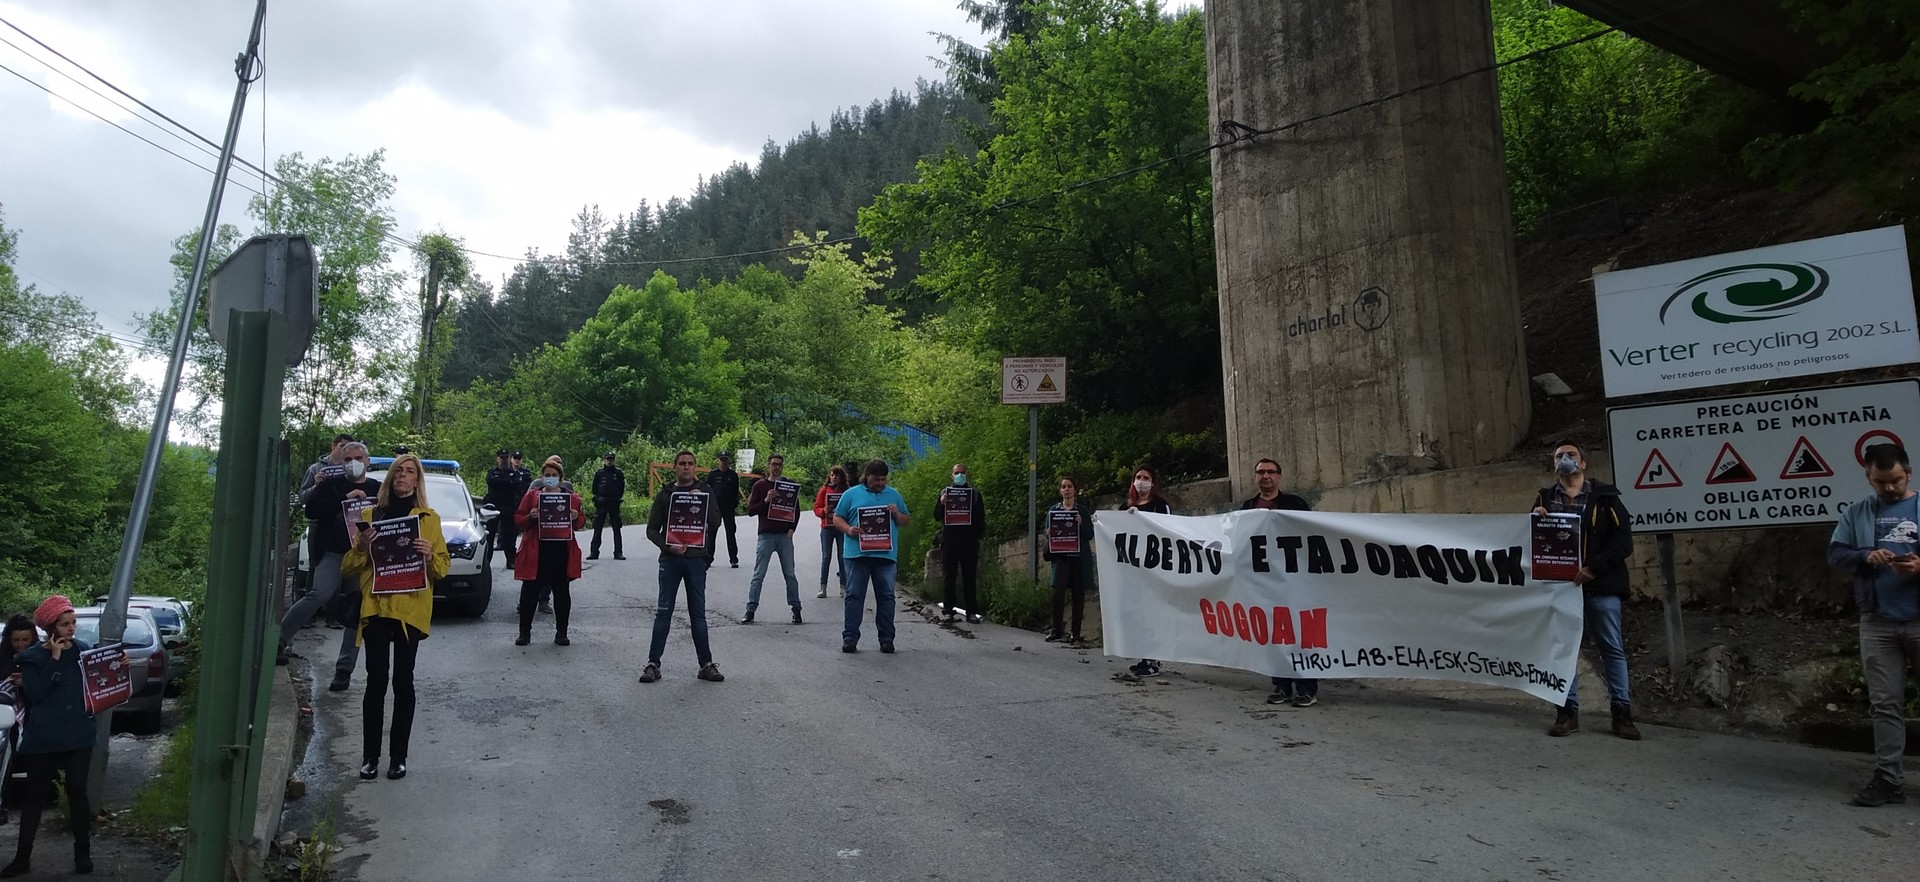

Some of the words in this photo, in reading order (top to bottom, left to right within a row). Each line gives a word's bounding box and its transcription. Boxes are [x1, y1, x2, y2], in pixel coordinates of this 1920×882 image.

[1608, 342, 1700, 367] Verter
[1713, 330, 1819, 357] recycling
[1826, 323, 1875, 342] 2002
[1879, 320, 1911, 335] S.L.
[1660, 370, 1711, 380] Vertedero
[1730, 361, 1774, 373] residuos
[1777, 359, 1790, 367] no
[1794, 352, 1850, 366] peligrosos
[1696, 393, 1819, 419] PRECAUCIÓN
[1636, 421, 1744, 441] CARRETERA
[1757, 417, 1782, 431] DE
[1791, 405, 1892, 428] MONTAÑA
[1719, 459, 1736, 472] 15%
[1703, 485, 1832, 505] OBLIGATORIO
[1694, 508, 1731, 522] CON
[1738, 507, 1760, 520] LA
[1766, 503, 1829, 519] CARGA
[1115, 532, 1223, 575] ALBERTO
[1199, 598, 1328, 649] GOGOAN
